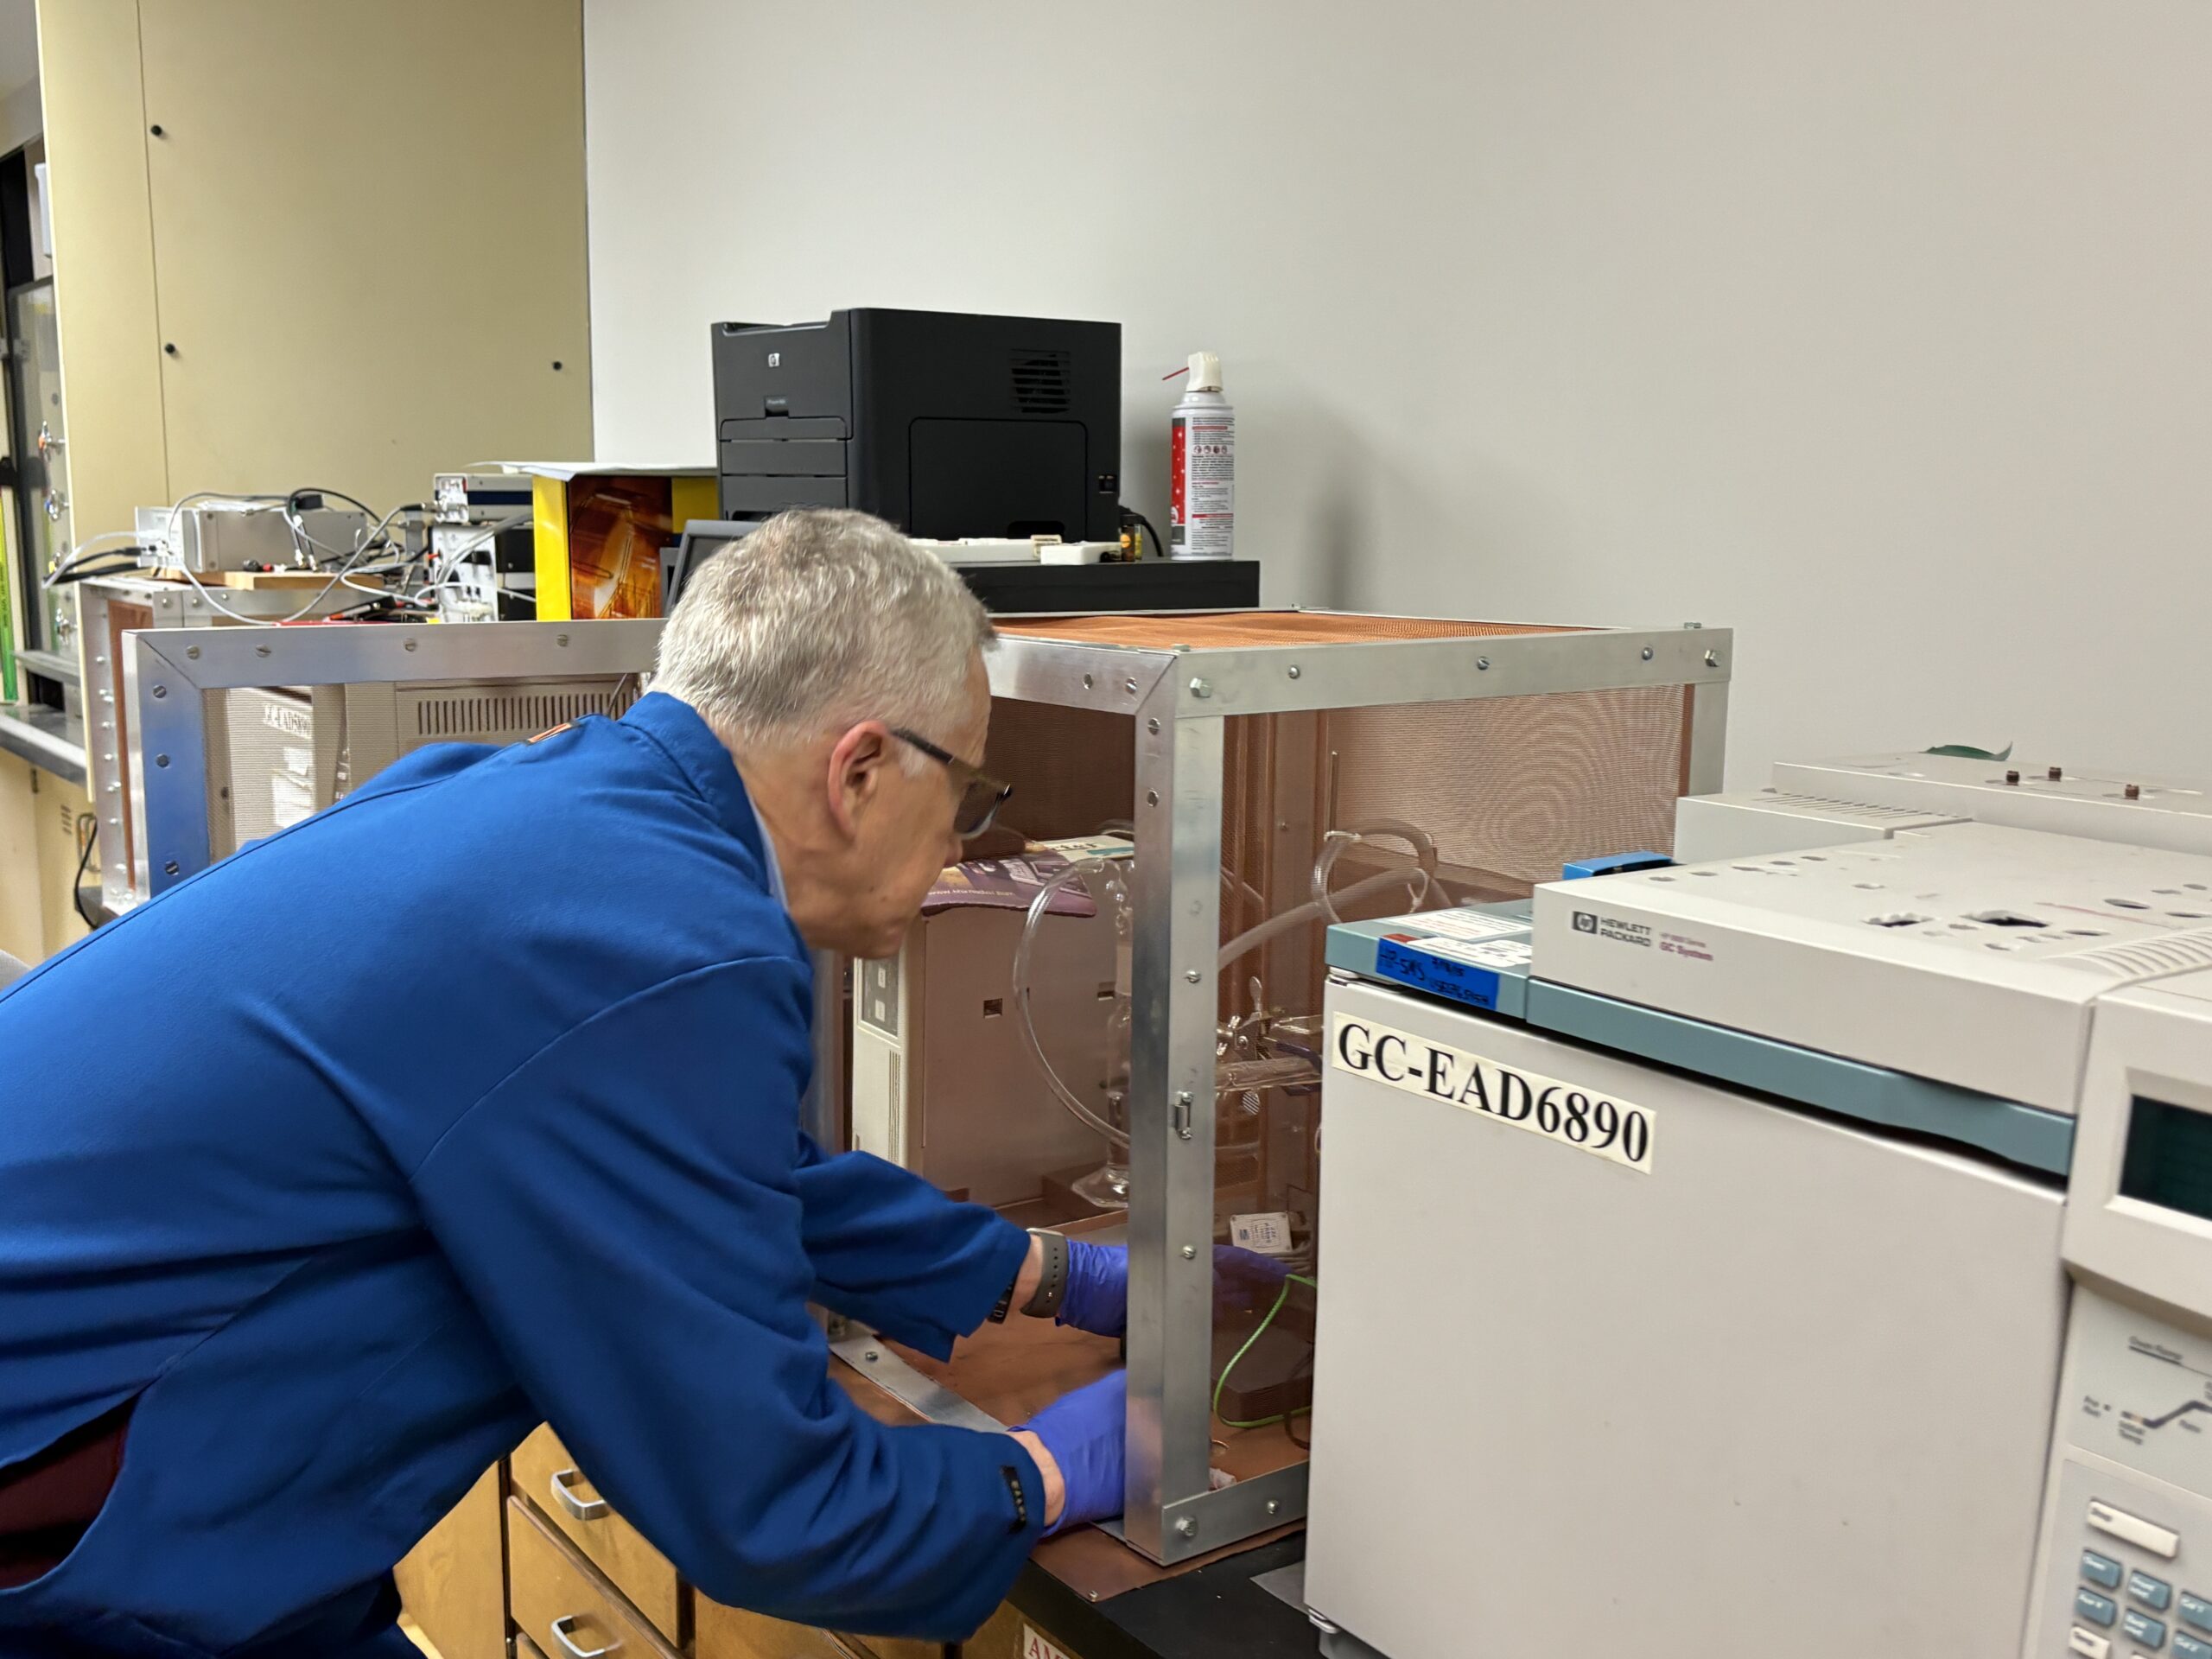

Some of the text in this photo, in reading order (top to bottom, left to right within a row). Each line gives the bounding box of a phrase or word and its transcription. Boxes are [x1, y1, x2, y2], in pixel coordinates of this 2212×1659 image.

[1600, 918, 1652, 936] HEWLETT
[1600, 928, 1652, 948] PACKARD
[1338, 1023, 1649, 1162] GC-EAD6890
